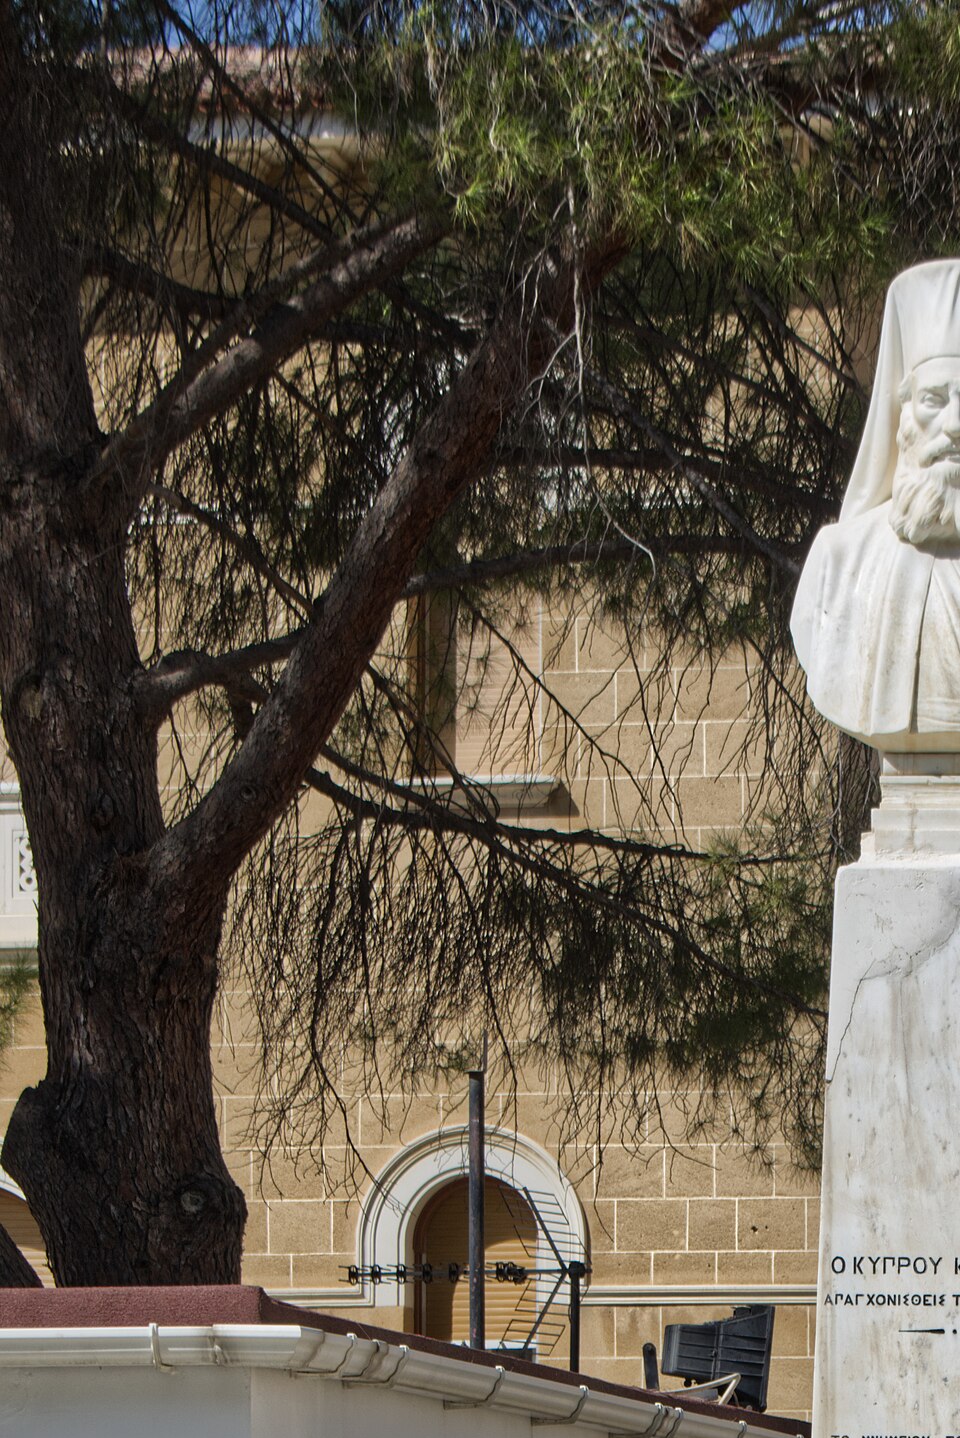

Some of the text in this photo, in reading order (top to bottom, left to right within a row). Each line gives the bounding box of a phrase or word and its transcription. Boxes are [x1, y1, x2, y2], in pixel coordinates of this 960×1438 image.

[831, 1256, 846, 1274] Ο
[853, 1256, 942, 1275] ΚΥΠΡΟΥ
[824, 1294, 946, 1306] ΑΠΑΓΧΟΝΙΣΘΕΙΣ
